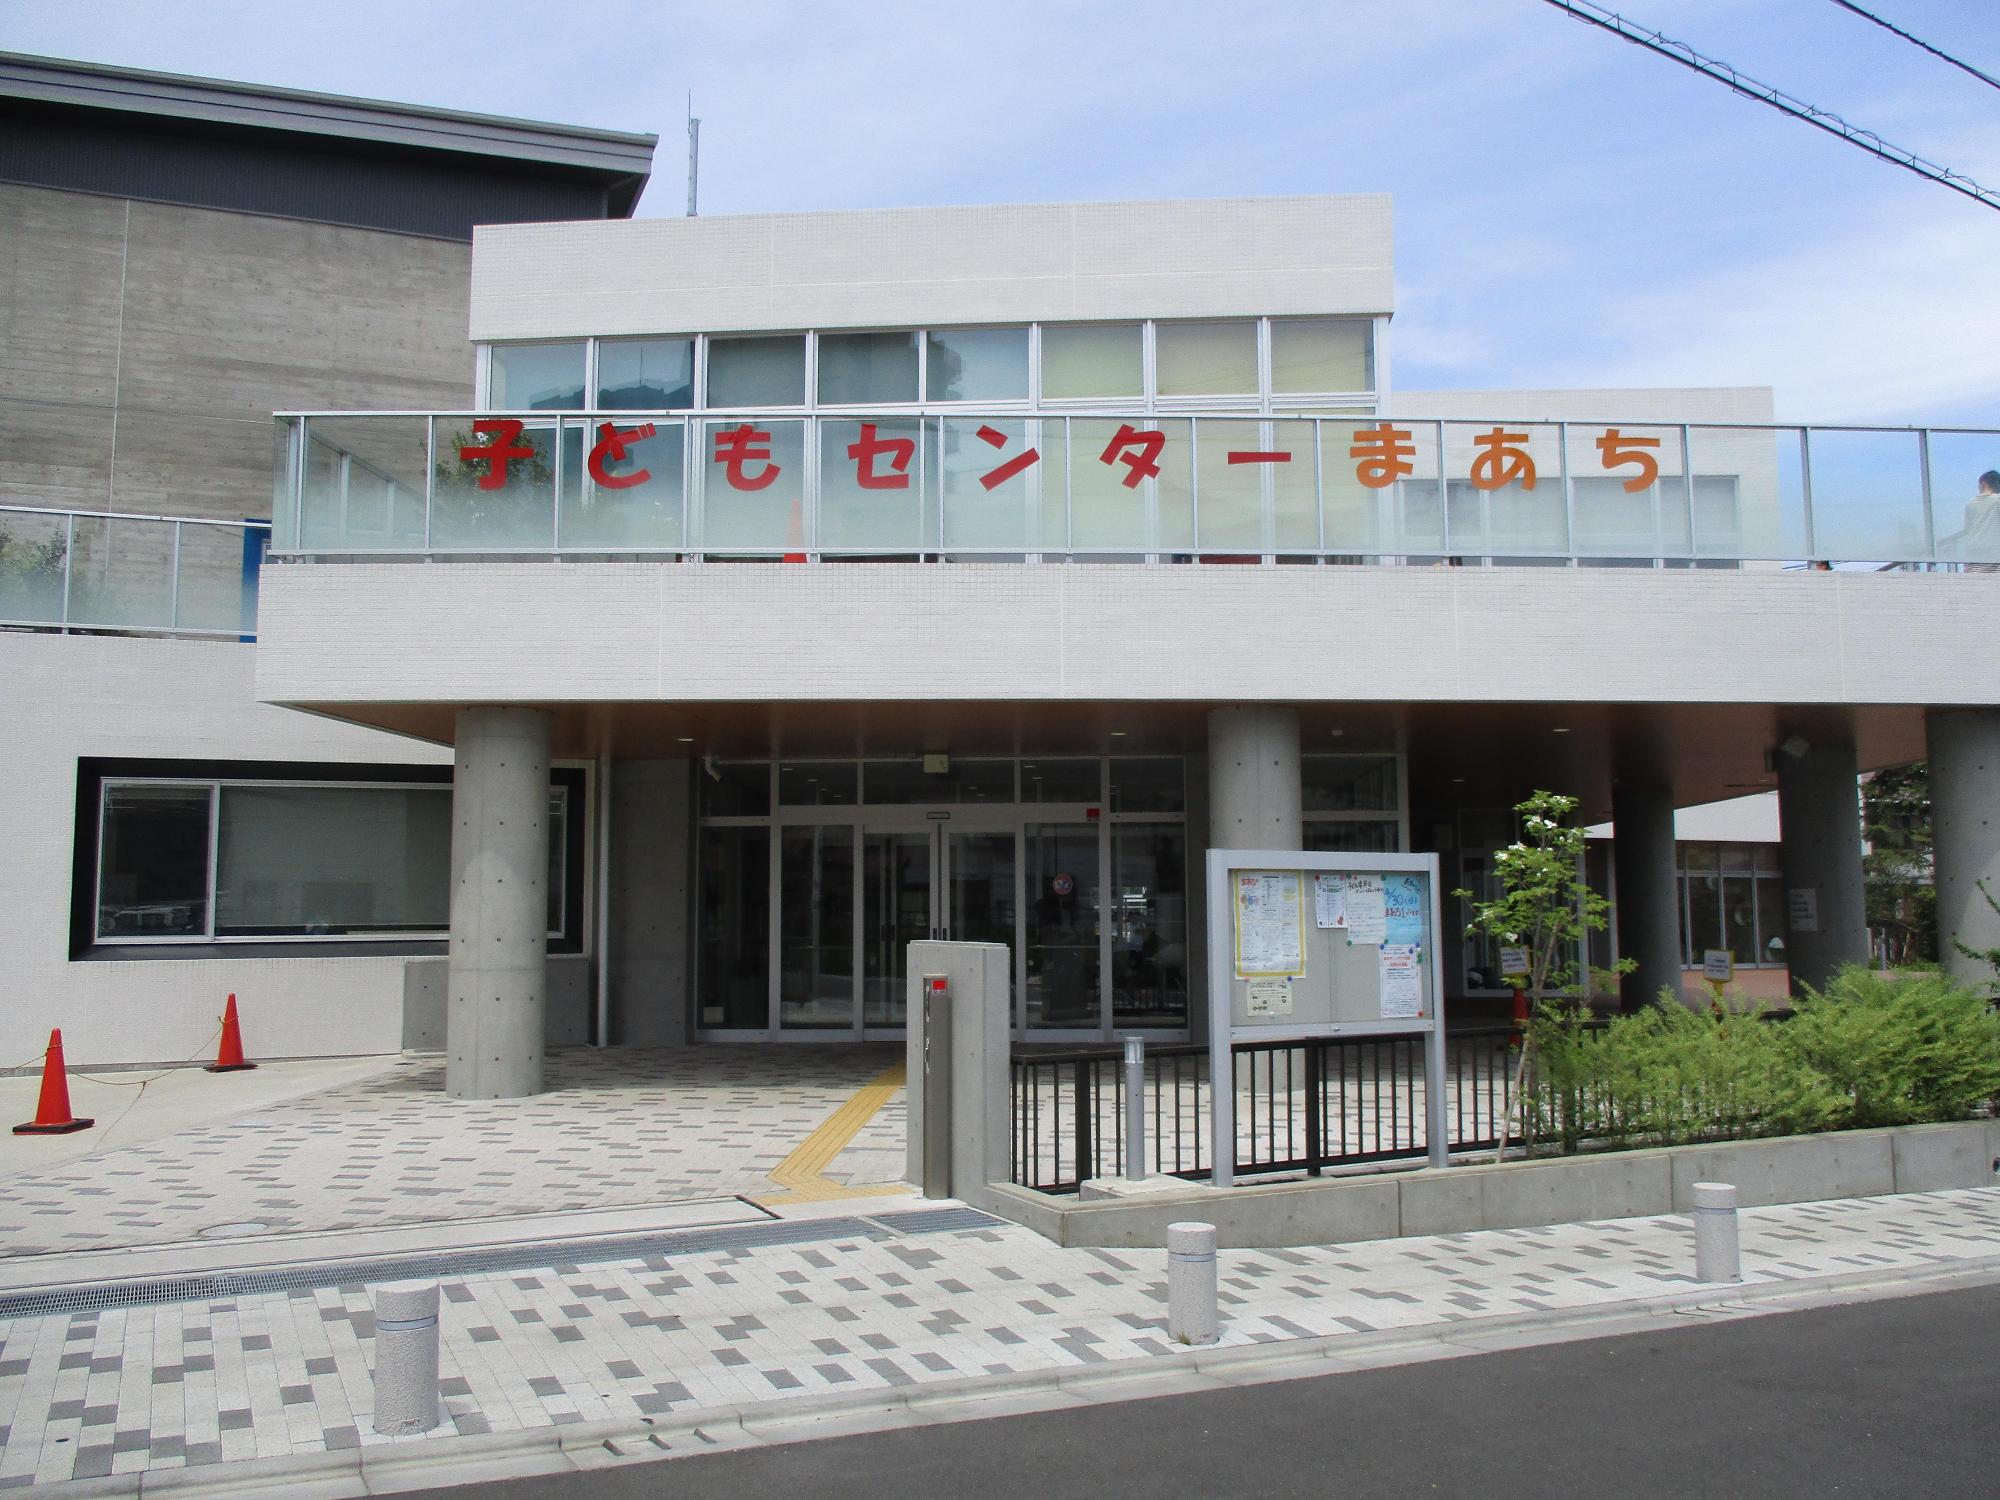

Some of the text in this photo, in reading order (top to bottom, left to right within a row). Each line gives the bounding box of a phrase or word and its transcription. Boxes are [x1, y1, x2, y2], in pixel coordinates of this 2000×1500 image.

[459, 419, 1660, 492] 子どもセンターまあち
